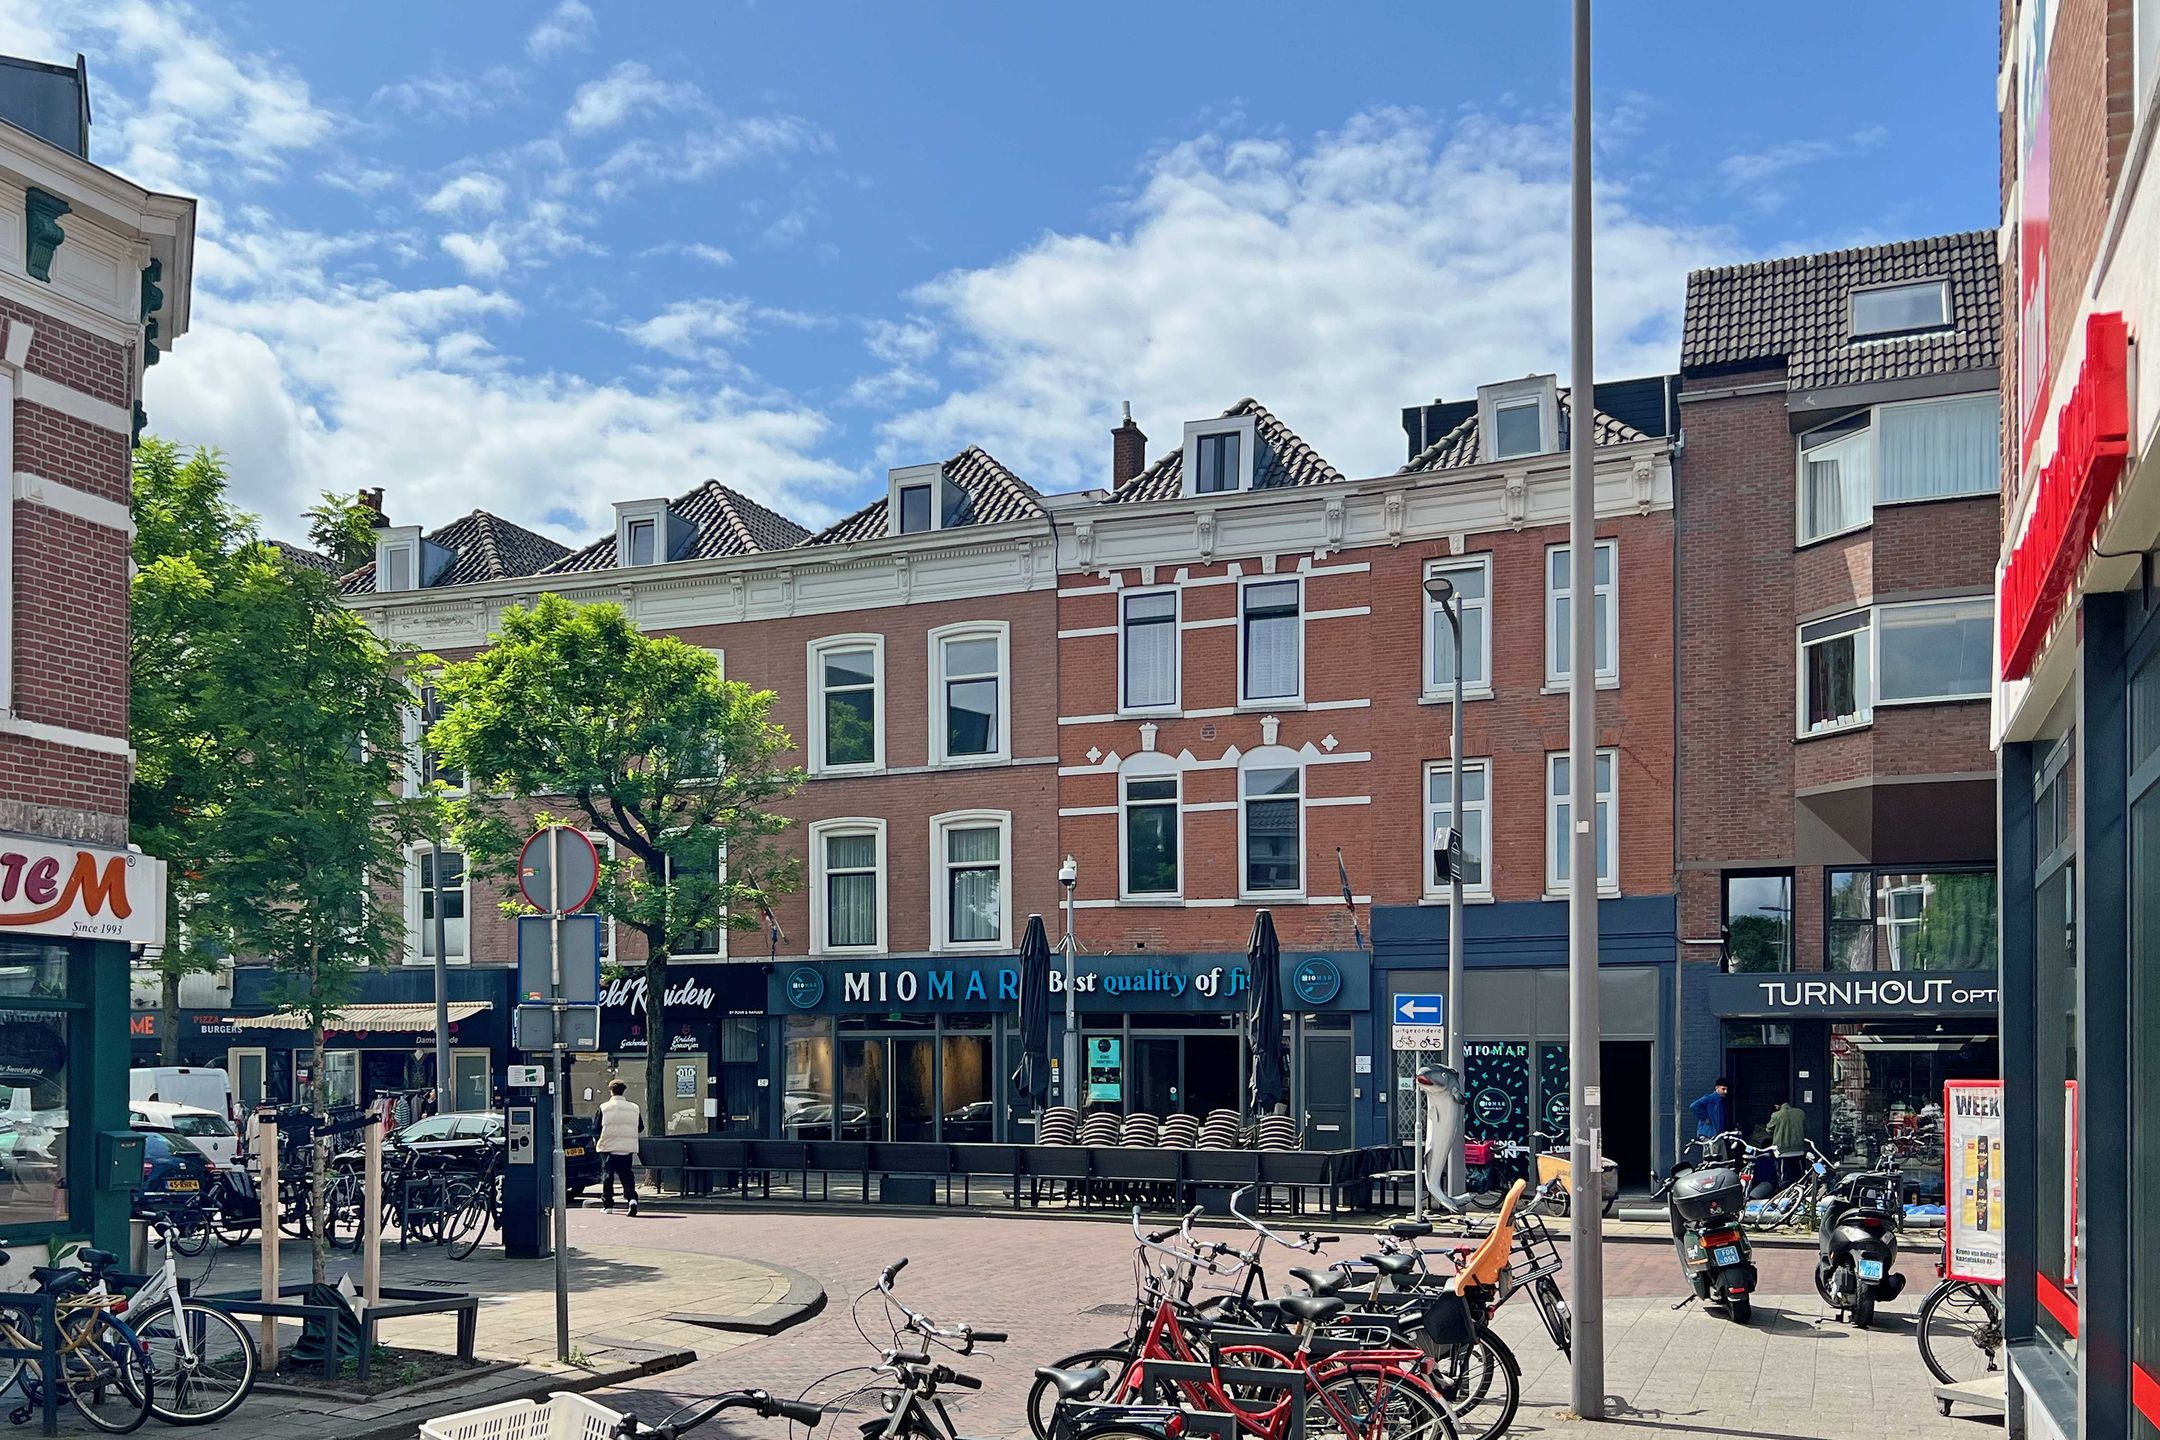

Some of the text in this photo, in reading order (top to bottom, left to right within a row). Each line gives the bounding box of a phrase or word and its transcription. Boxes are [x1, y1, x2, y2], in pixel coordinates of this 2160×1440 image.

[72, 921, 123, 935] Since 1993
[1104, 968, 1187, 997] quality
[1195, 967, 1222, 997] of
[599, 976, 715, 1016] eld Kuiden
[1759, 980, 1953, 1006] TURNHOUT
[201, 1025, 243, 1034] BURGERS
[1463, 1045, 1525, 1056] MIOMAR
